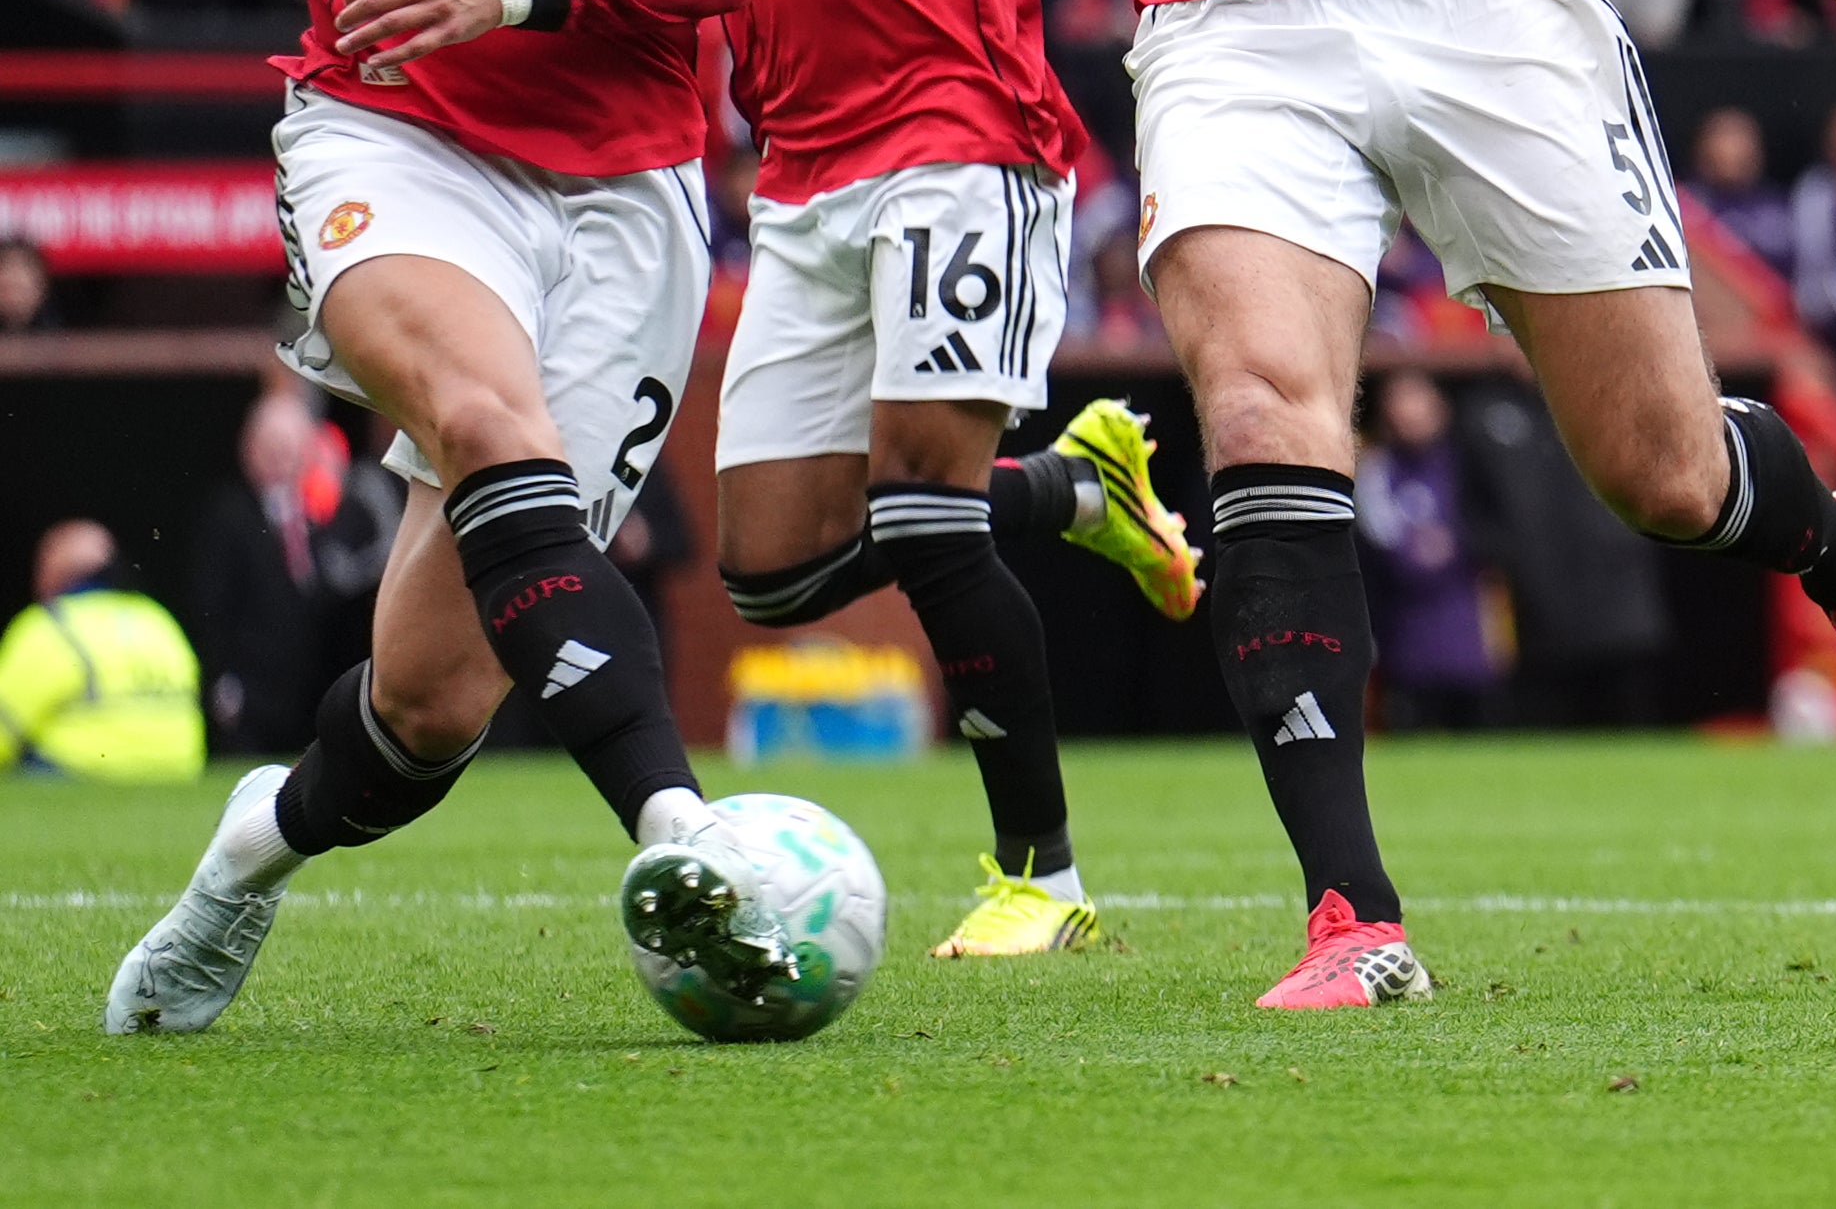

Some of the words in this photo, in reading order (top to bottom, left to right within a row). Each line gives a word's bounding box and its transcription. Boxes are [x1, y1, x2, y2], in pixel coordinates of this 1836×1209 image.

[1602, 119, 1652, 217] 5
[903, 227, 1002, 322] 16
[611, 376, 673, 491] 2
[492, 574, 584, 633] MUFC
[1237, 630, 1341, 661] MUFC
